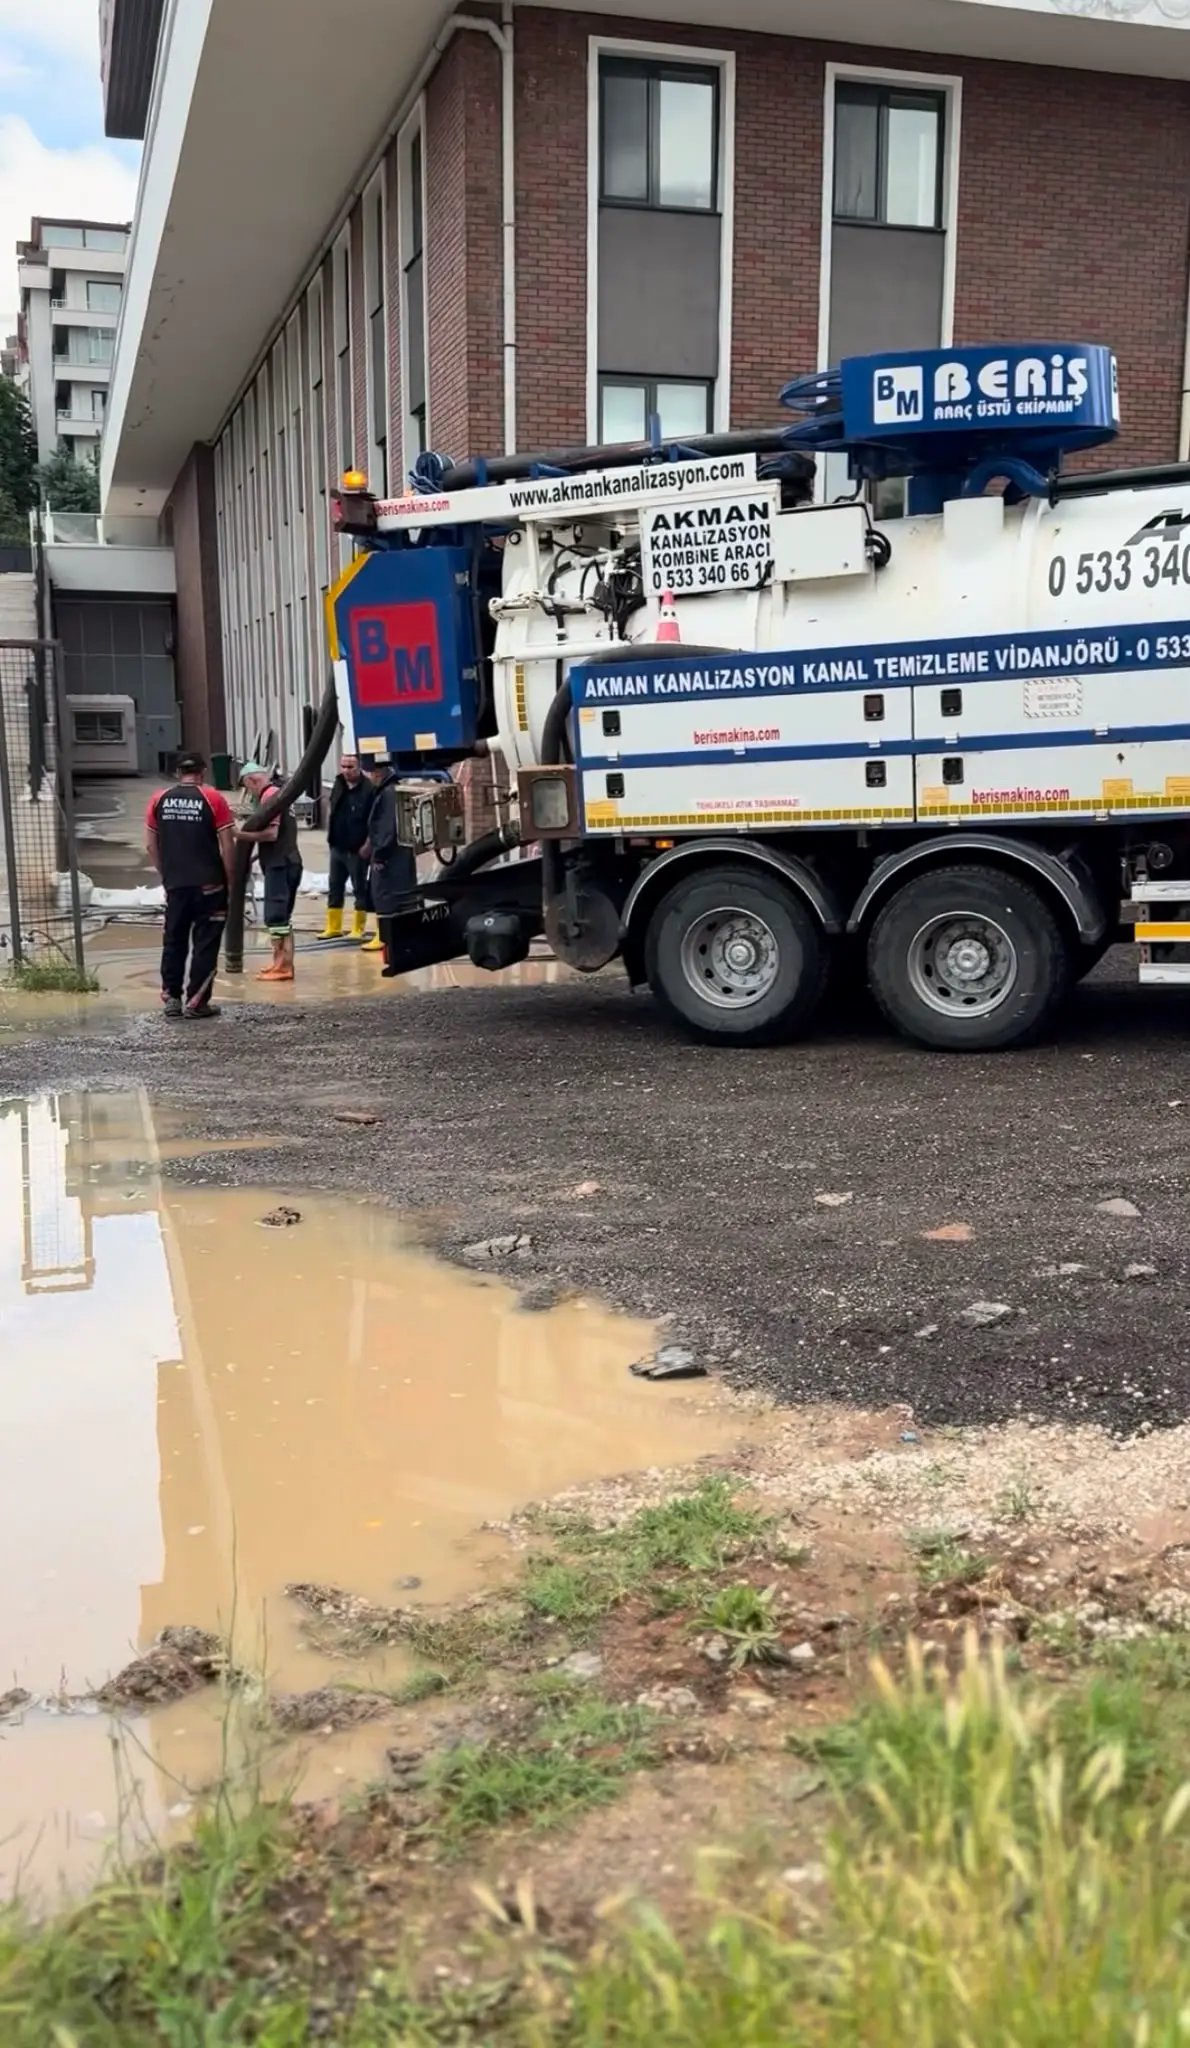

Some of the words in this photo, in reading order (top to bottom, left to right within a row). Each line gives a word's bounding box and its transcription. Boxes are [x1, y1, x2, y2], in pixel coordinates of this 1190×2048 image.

[933, 405, 973, 421] ARAÇ
[977, 398, 1011, 416] ÜSTÜ
[510, 461, 744, 508] www.akmankanalizasyon.com
[651, 502, 769, 532] AKMAN
[1123, 508, 1190, 546] A
[724, 542, 771, 562] ARACI
[653, 571, 662, 590] 0
[666, 567, 694, 588] 533
[699, 564, 726, 585] 340
[731, 562, 749, 582] 66
[1049, 555, 1066, 597] 0
[1076, 548, 1131, 594] 533
[585, 676, 648, 698] AKMAN
[803, 660, 869, 684] KANAL
[995, 637, 1119, 671] VİDANJÖRÜ
[1137, 638, 1149, 661] 0
[693, 727, 780, 745] berismakina.com
[162, 798, 203, 810] AKMAN
[972, 787, 1070, 804] berismakina.com
